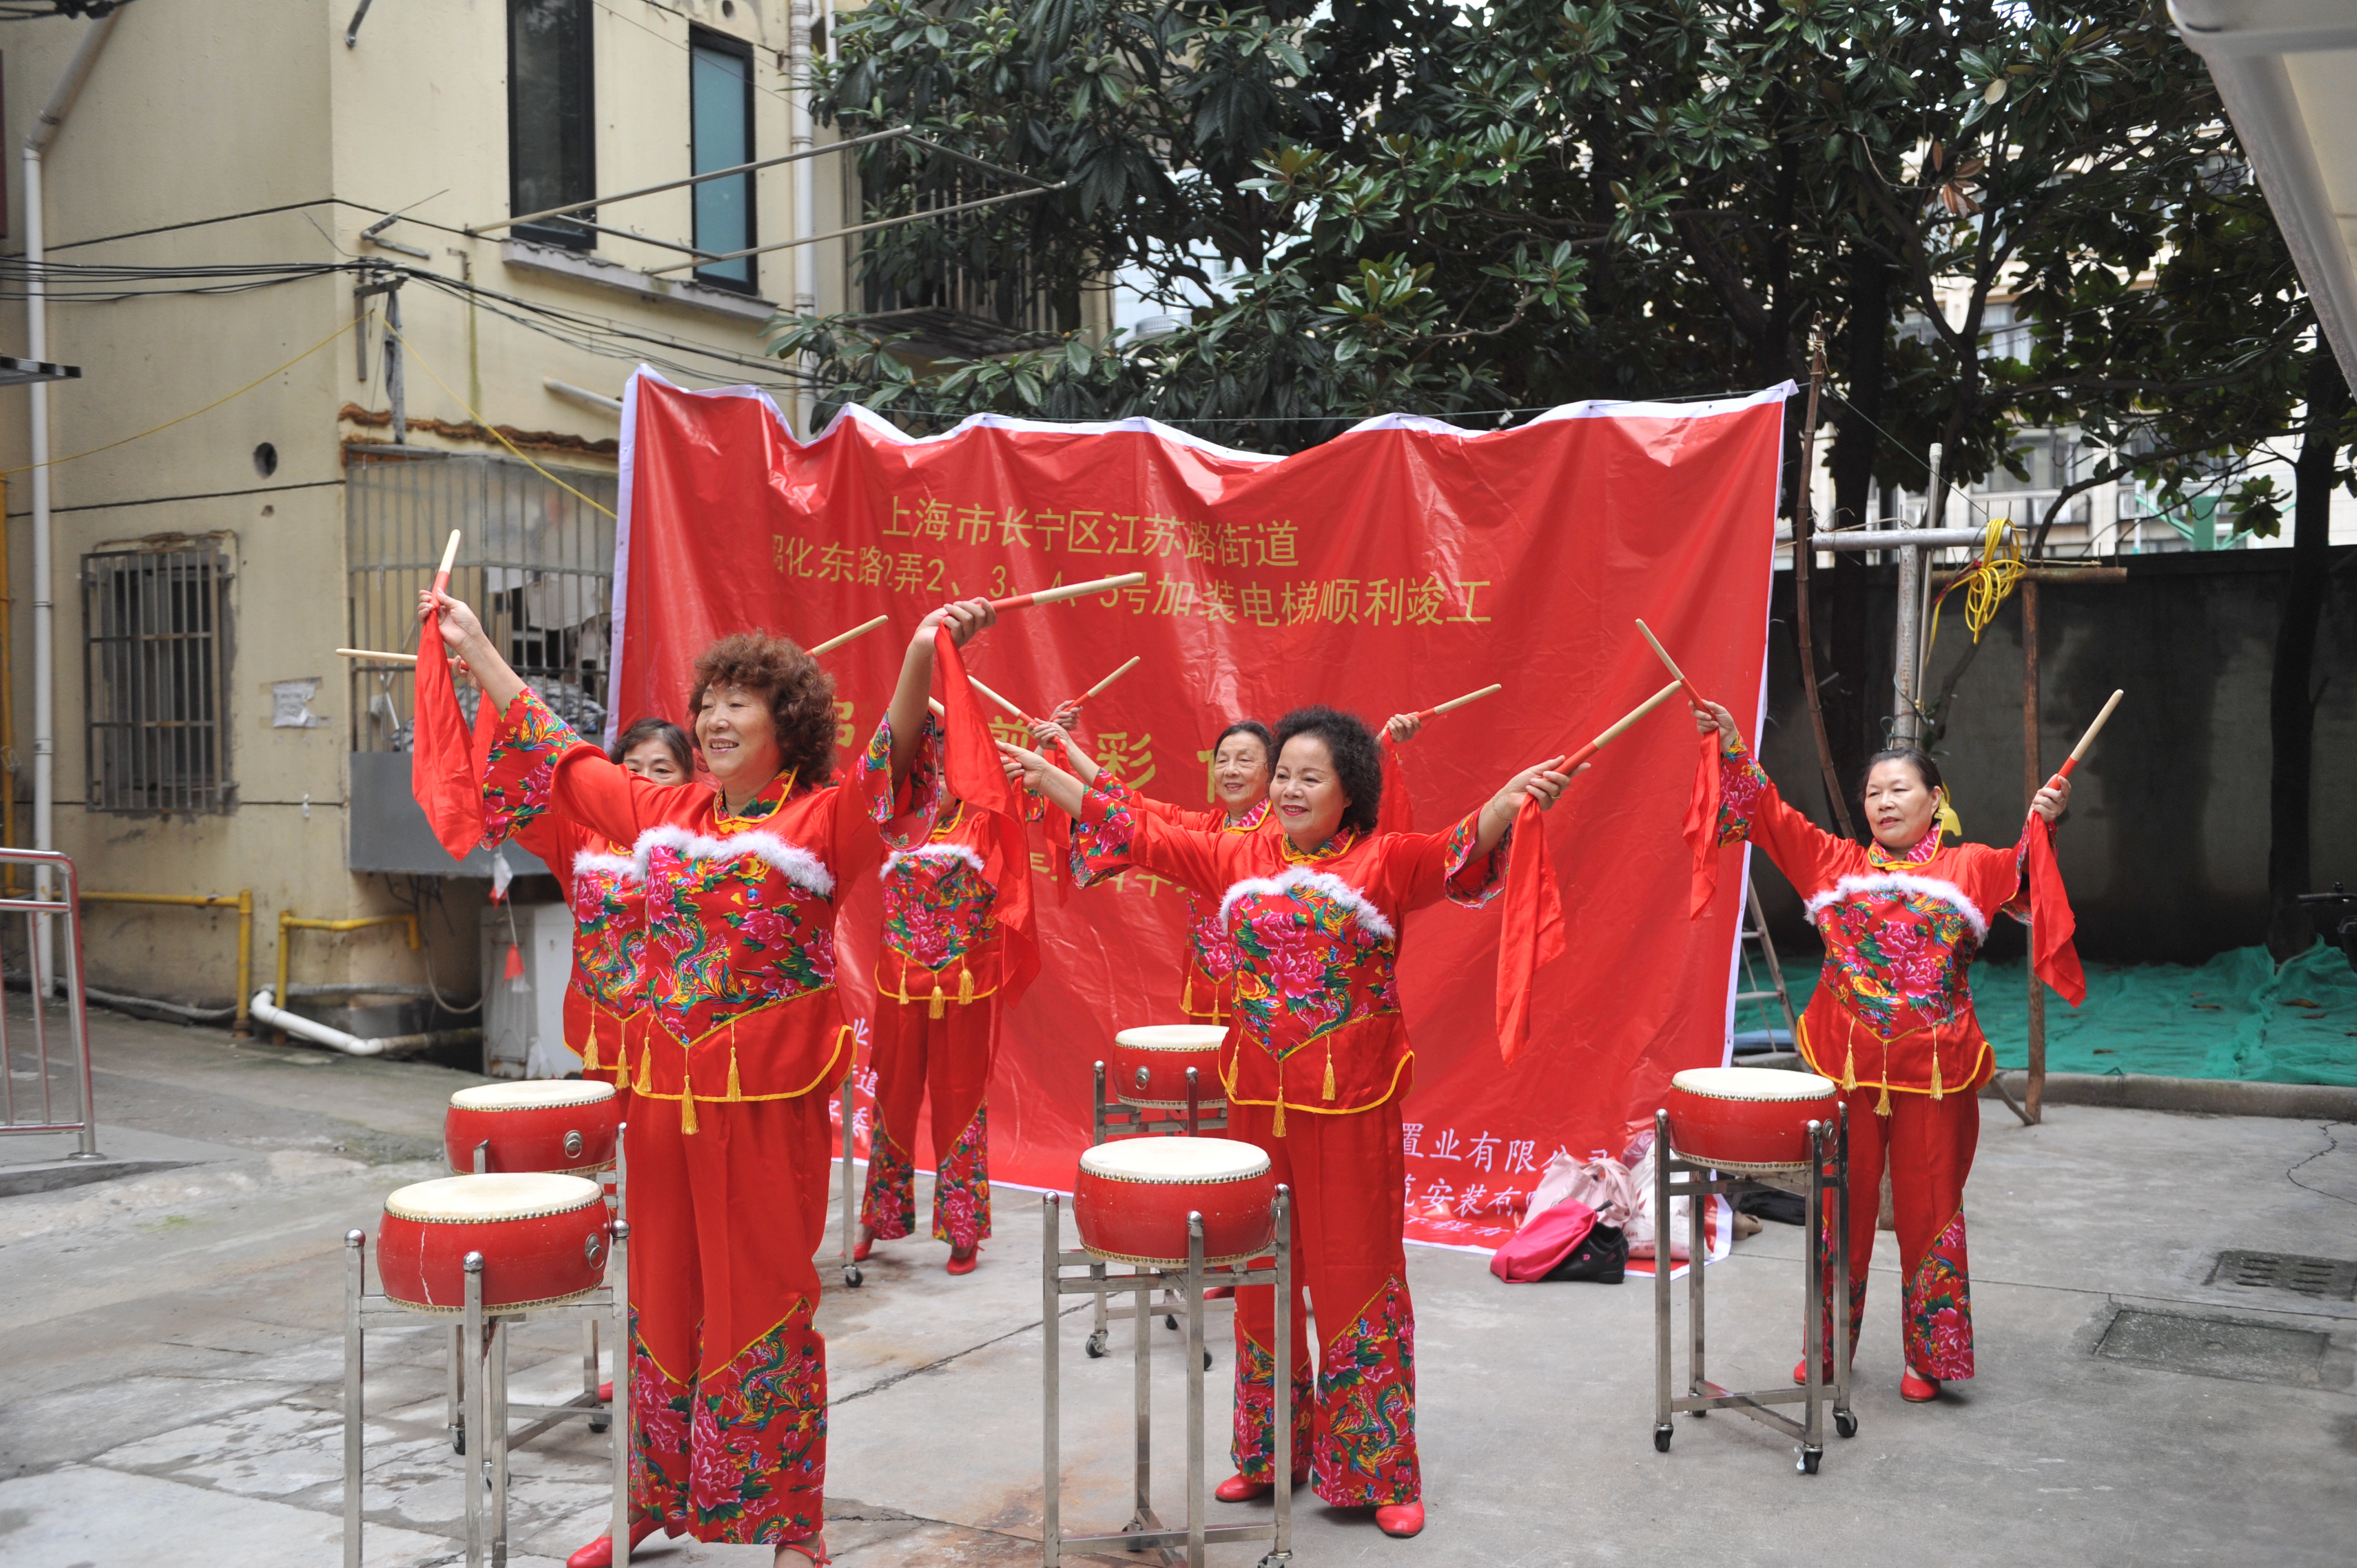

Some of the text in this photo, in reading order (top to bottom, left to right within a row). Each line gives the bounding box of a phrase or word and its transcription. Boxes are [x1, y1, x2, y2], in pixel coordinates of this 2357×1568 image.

[882, 496, 1299, 568] 上海市长宁区江苏路街道
